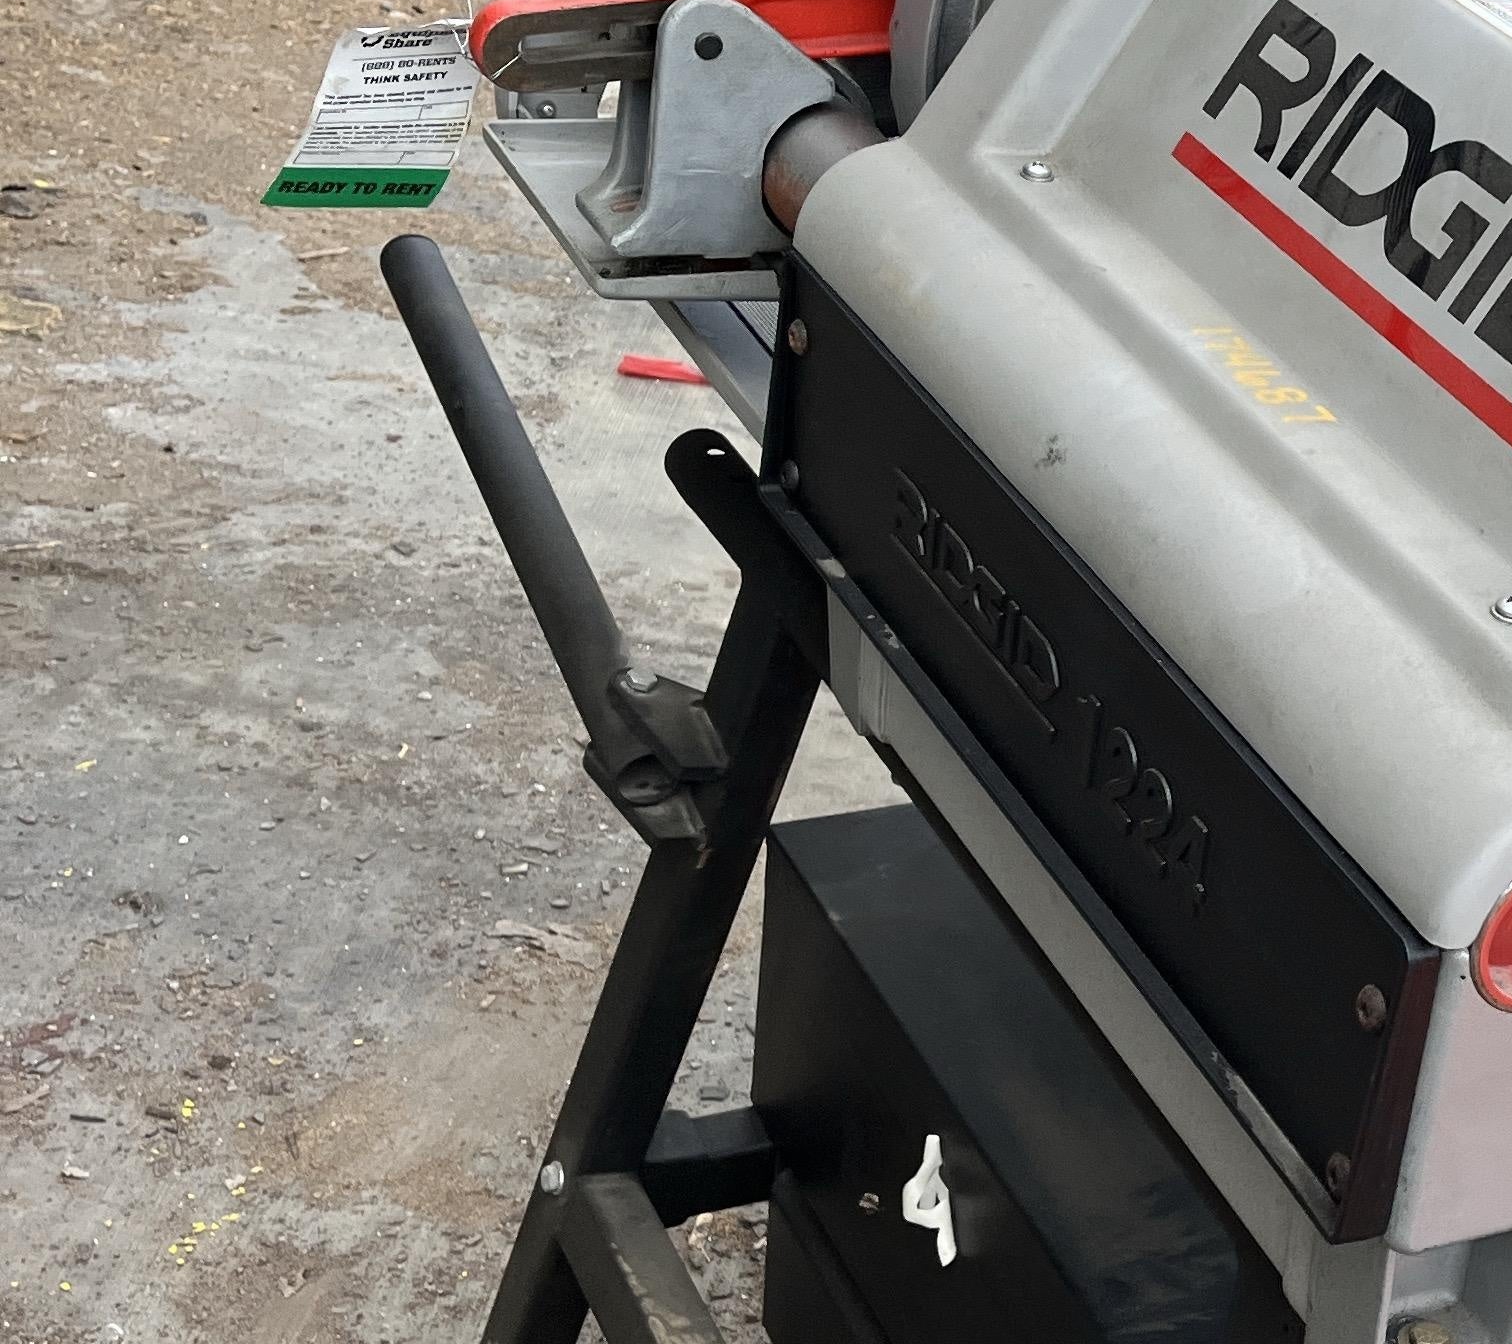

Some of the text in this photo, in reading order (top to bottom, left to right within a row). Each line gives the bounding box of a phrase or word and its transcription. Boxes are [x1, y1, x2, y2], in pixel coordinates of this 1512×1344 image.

[383, 38, 433, 49] Share
[363, 71, 448, 85] THINK SAFETY
[278, 181, 437, 196] READY TO RENT
